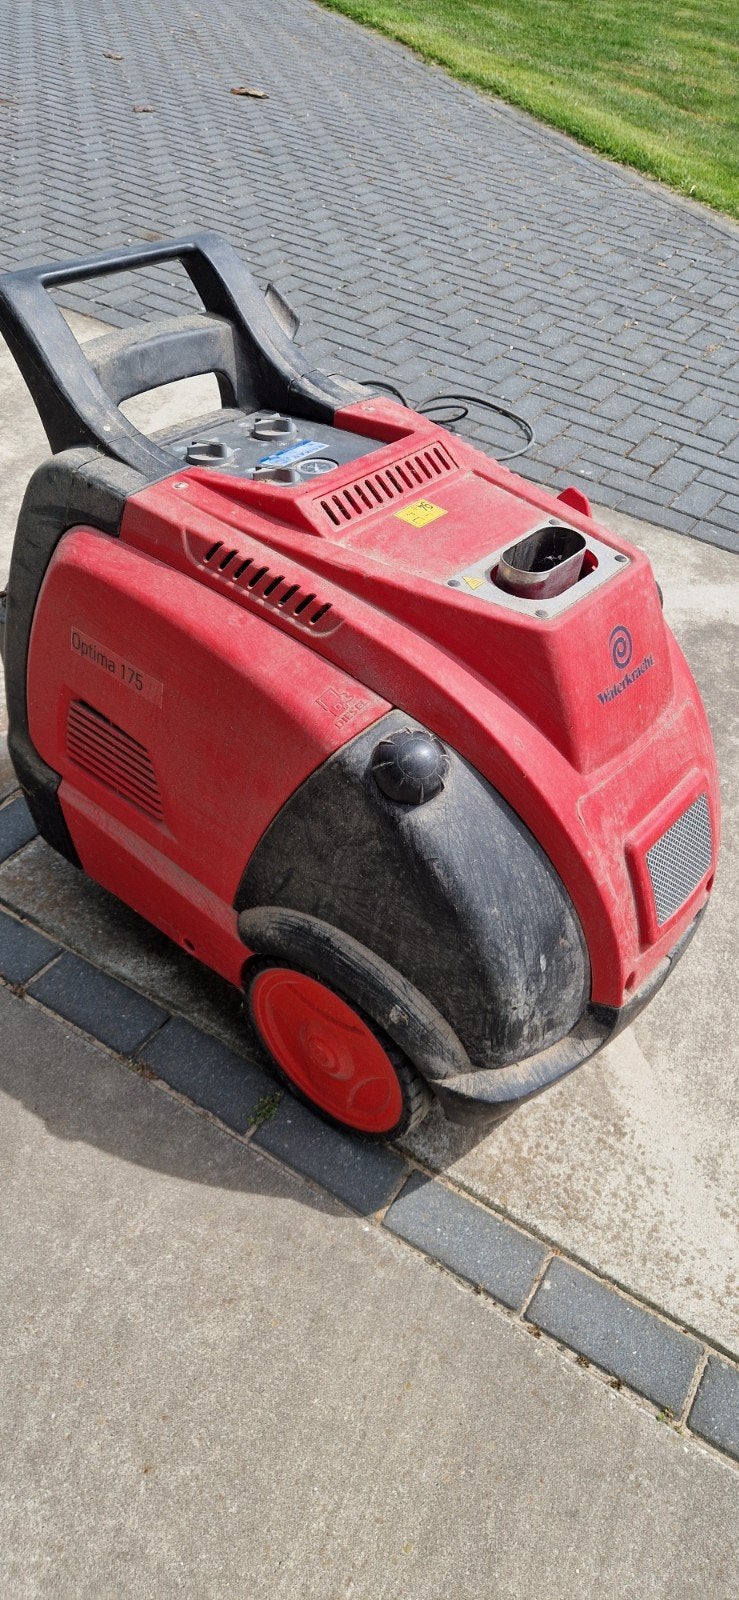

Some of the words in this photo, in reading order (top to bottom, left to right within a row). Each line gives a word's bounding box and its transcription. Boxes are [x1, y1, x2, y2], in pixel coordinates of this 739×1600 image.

[71, 632, 116, 673] Optima
[120, 664, 143, 691] 175
[597, 653, 654, 705] Waterkracht
